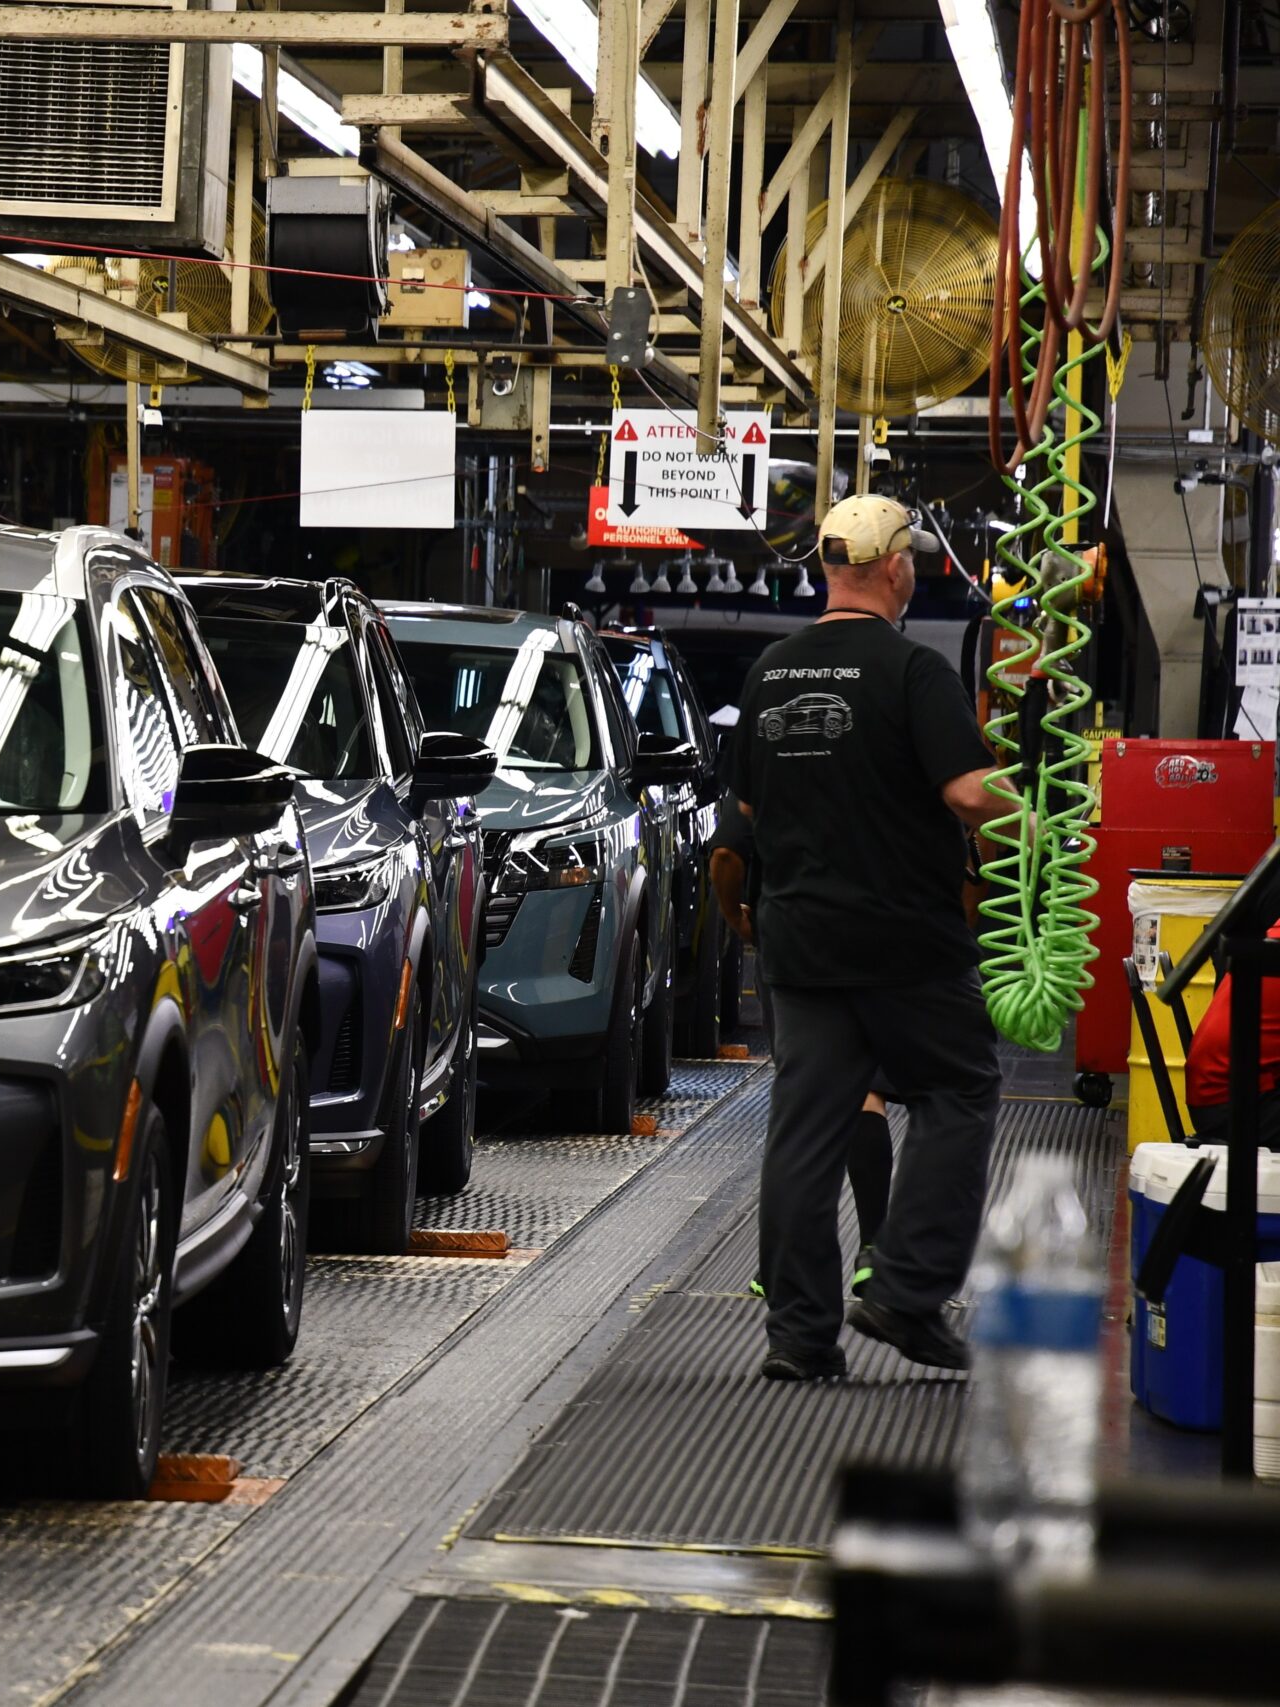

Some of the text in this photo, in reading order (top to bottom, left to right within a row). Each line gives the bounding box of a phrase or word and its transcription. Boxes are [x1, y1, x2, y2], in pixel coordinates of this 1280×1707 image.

[646, 425, 736, 440] ATTENN
[642, 450, 738, 464] DO NOT WORK
[661, 469, 716, 481] BEYOND
[648, 486, 677, 499] THIS
[680, 488, 722, 500] POINT
[616, 526, 679, 536] AUTHORIZED
[603, 533, 690, 545] PERSONNEL ONLY
[762, 667, 861, 682] 2027 INFINITI QX65
[1083, 730, 1122, 740] CAUTION
